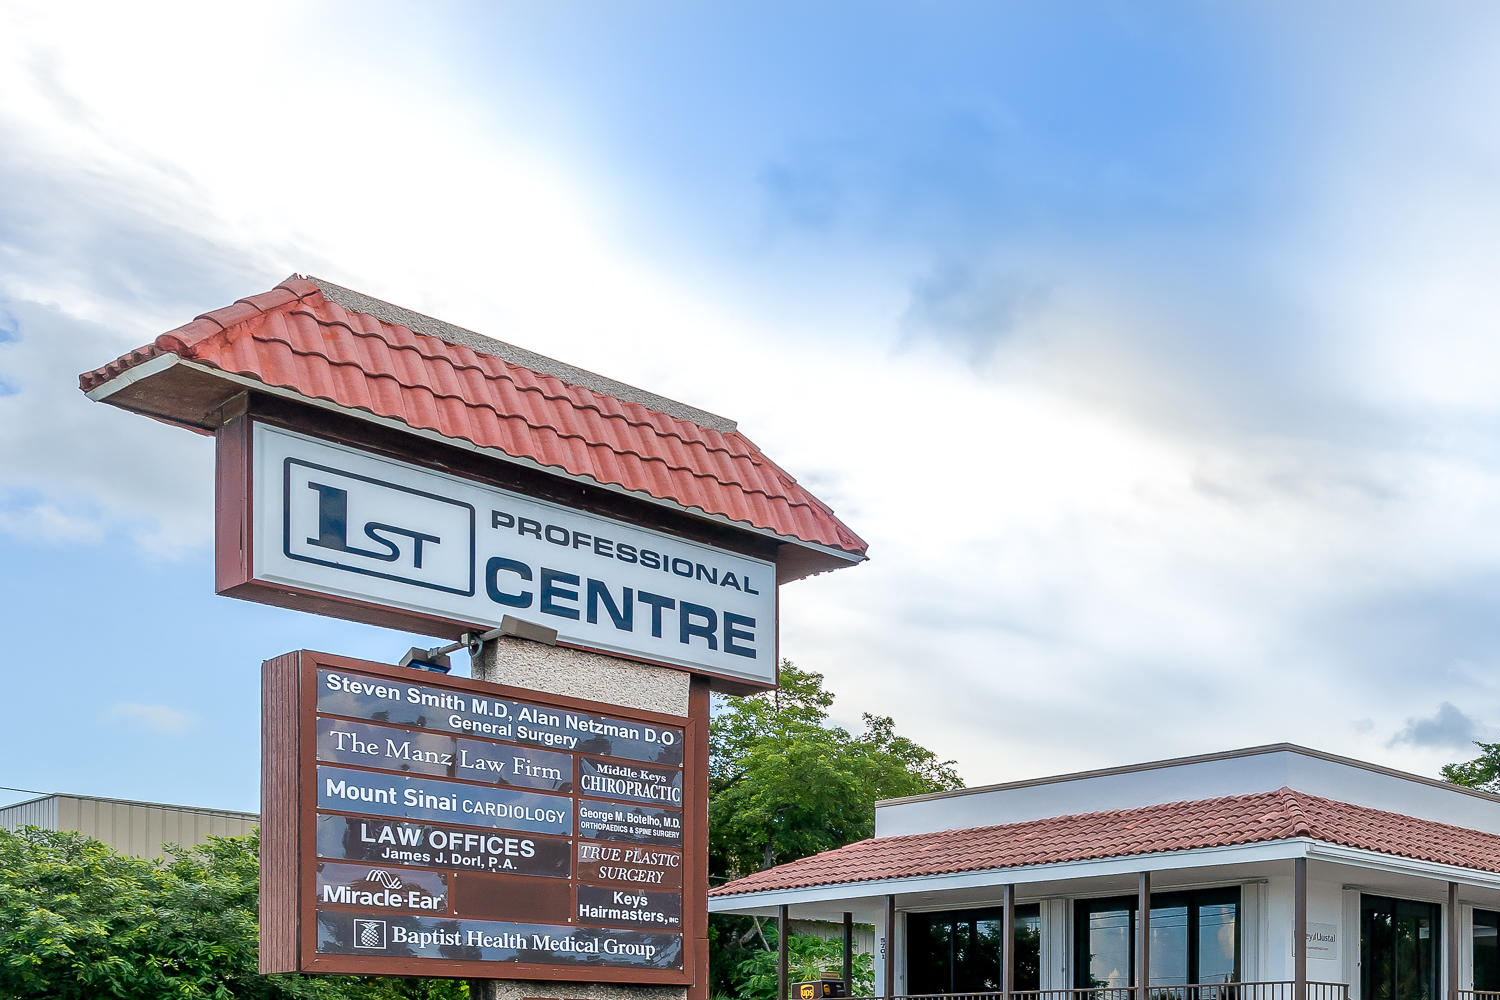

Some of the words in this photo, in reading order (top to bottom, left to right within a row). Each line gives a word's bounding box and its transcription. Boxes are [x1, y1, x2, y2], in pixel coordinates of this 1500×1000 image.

[491, 510, 760, 595] PROFESSIONAL
[485, 556, 757, 659] CENTRE
[326, 674, 401, 700] Steven
[407, 687, 465, 712] Smith
[518, 707, 560, 727] Alan
[565, 714, 639, 740] Netzman
[645, 728, 675, 746] D.O
[448, 714, 512, 737] General
[516, 725, 578, 749] Surgery
[329, 731, 379, 755] The
[385, 739, 453, 766] Manz
[460, 749, 506, 773] Law
[512, 756, 563, 780] Firm
[596, 763, 638, 779] Middle
[640, 769, 667, 784] Keys
[326, 779, 397, 805] Mount
[403, 788, 457, 812] Sinai
[462, 799, 566, 823] CARDIOLOGY
[581, 774, 681, 802] CHIROPRACTIC
[580, 807, 614, 823] George
[615, 811, 625, 822] M.
[627, 812, 662, 828] Botelho,
[663, 816, 681, 829] M.D.
[580, 821, 628, 834] ORTHOPAEDICS
[635, 827, 652, 836] SPINE
[652, 829, 680, 839] SURGERY
[360, 823, 422, 847] LAW
[428, 830, 536, 858] OFFICES
[381, 847, 431, 862] James
[435, 852, 448, 864] J.
[451, 853, 485, 869] Dorl,
[488, 856, 517, 870] P.A.
[580, 845, 621, 861] TRUE
[624, 849, 680, 868] PLASTIC
[598, 865, 664, 884] SURGERY
[322, 884, 442, 910] Miracle-Ear
[613, 891, 648, 909] Keys
[579, 903, 668, 925] Hairmasters,
[391, 925, 462, 949] Baptist
[466, 930, 528, 950] Health
[532, 934, 600, 954] Medical
[603, 938, 656, 960] Group
